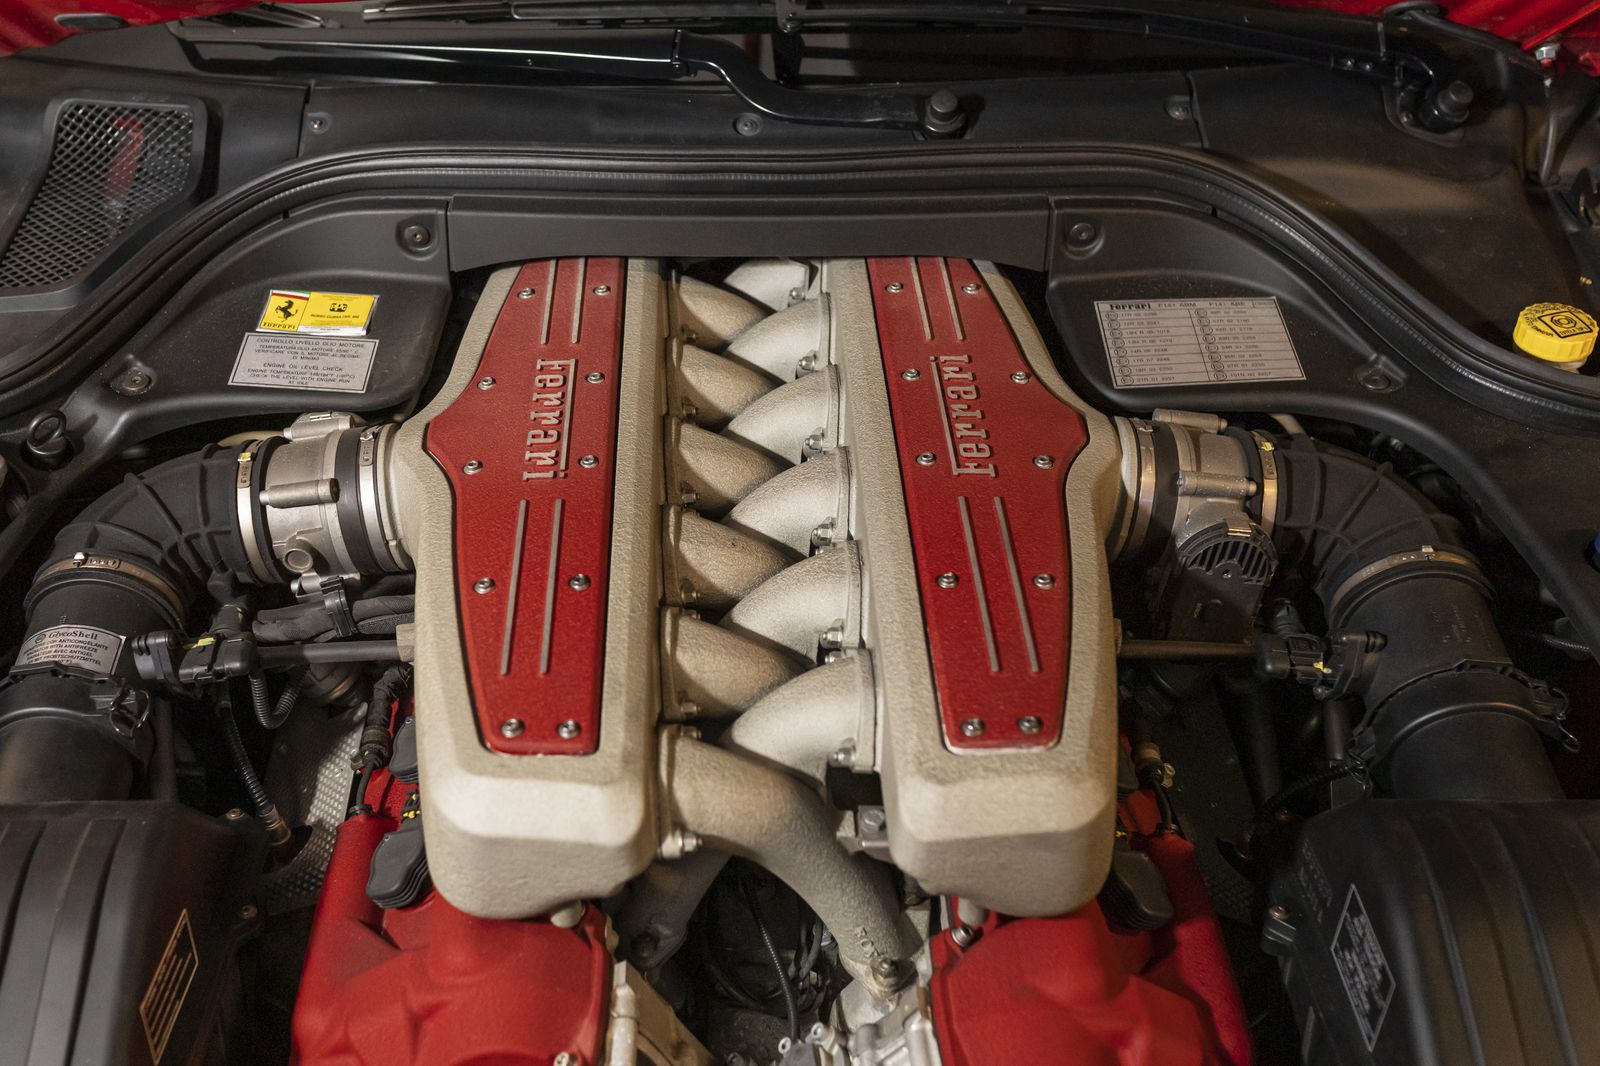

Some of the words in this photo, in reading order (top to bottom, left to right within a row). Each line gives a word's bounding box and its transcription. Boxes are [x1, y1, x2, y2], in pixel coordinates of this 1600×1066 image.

[262, 322, 296, 330] Ferrari
[523, 358, 576, 481] Ferrari
[930, 354, 996, 478] Ferrari
[48, 630, 98, 640] GlycoShell
[58, 639, 108, 650] ANTICONGELANTE
[64, 644, 98, 652] ANTIFREEZE
[69, 650, 93, 658] ANTIGEL
[43, 654, 102, 666] FROSTSCHUTZMITTEL
